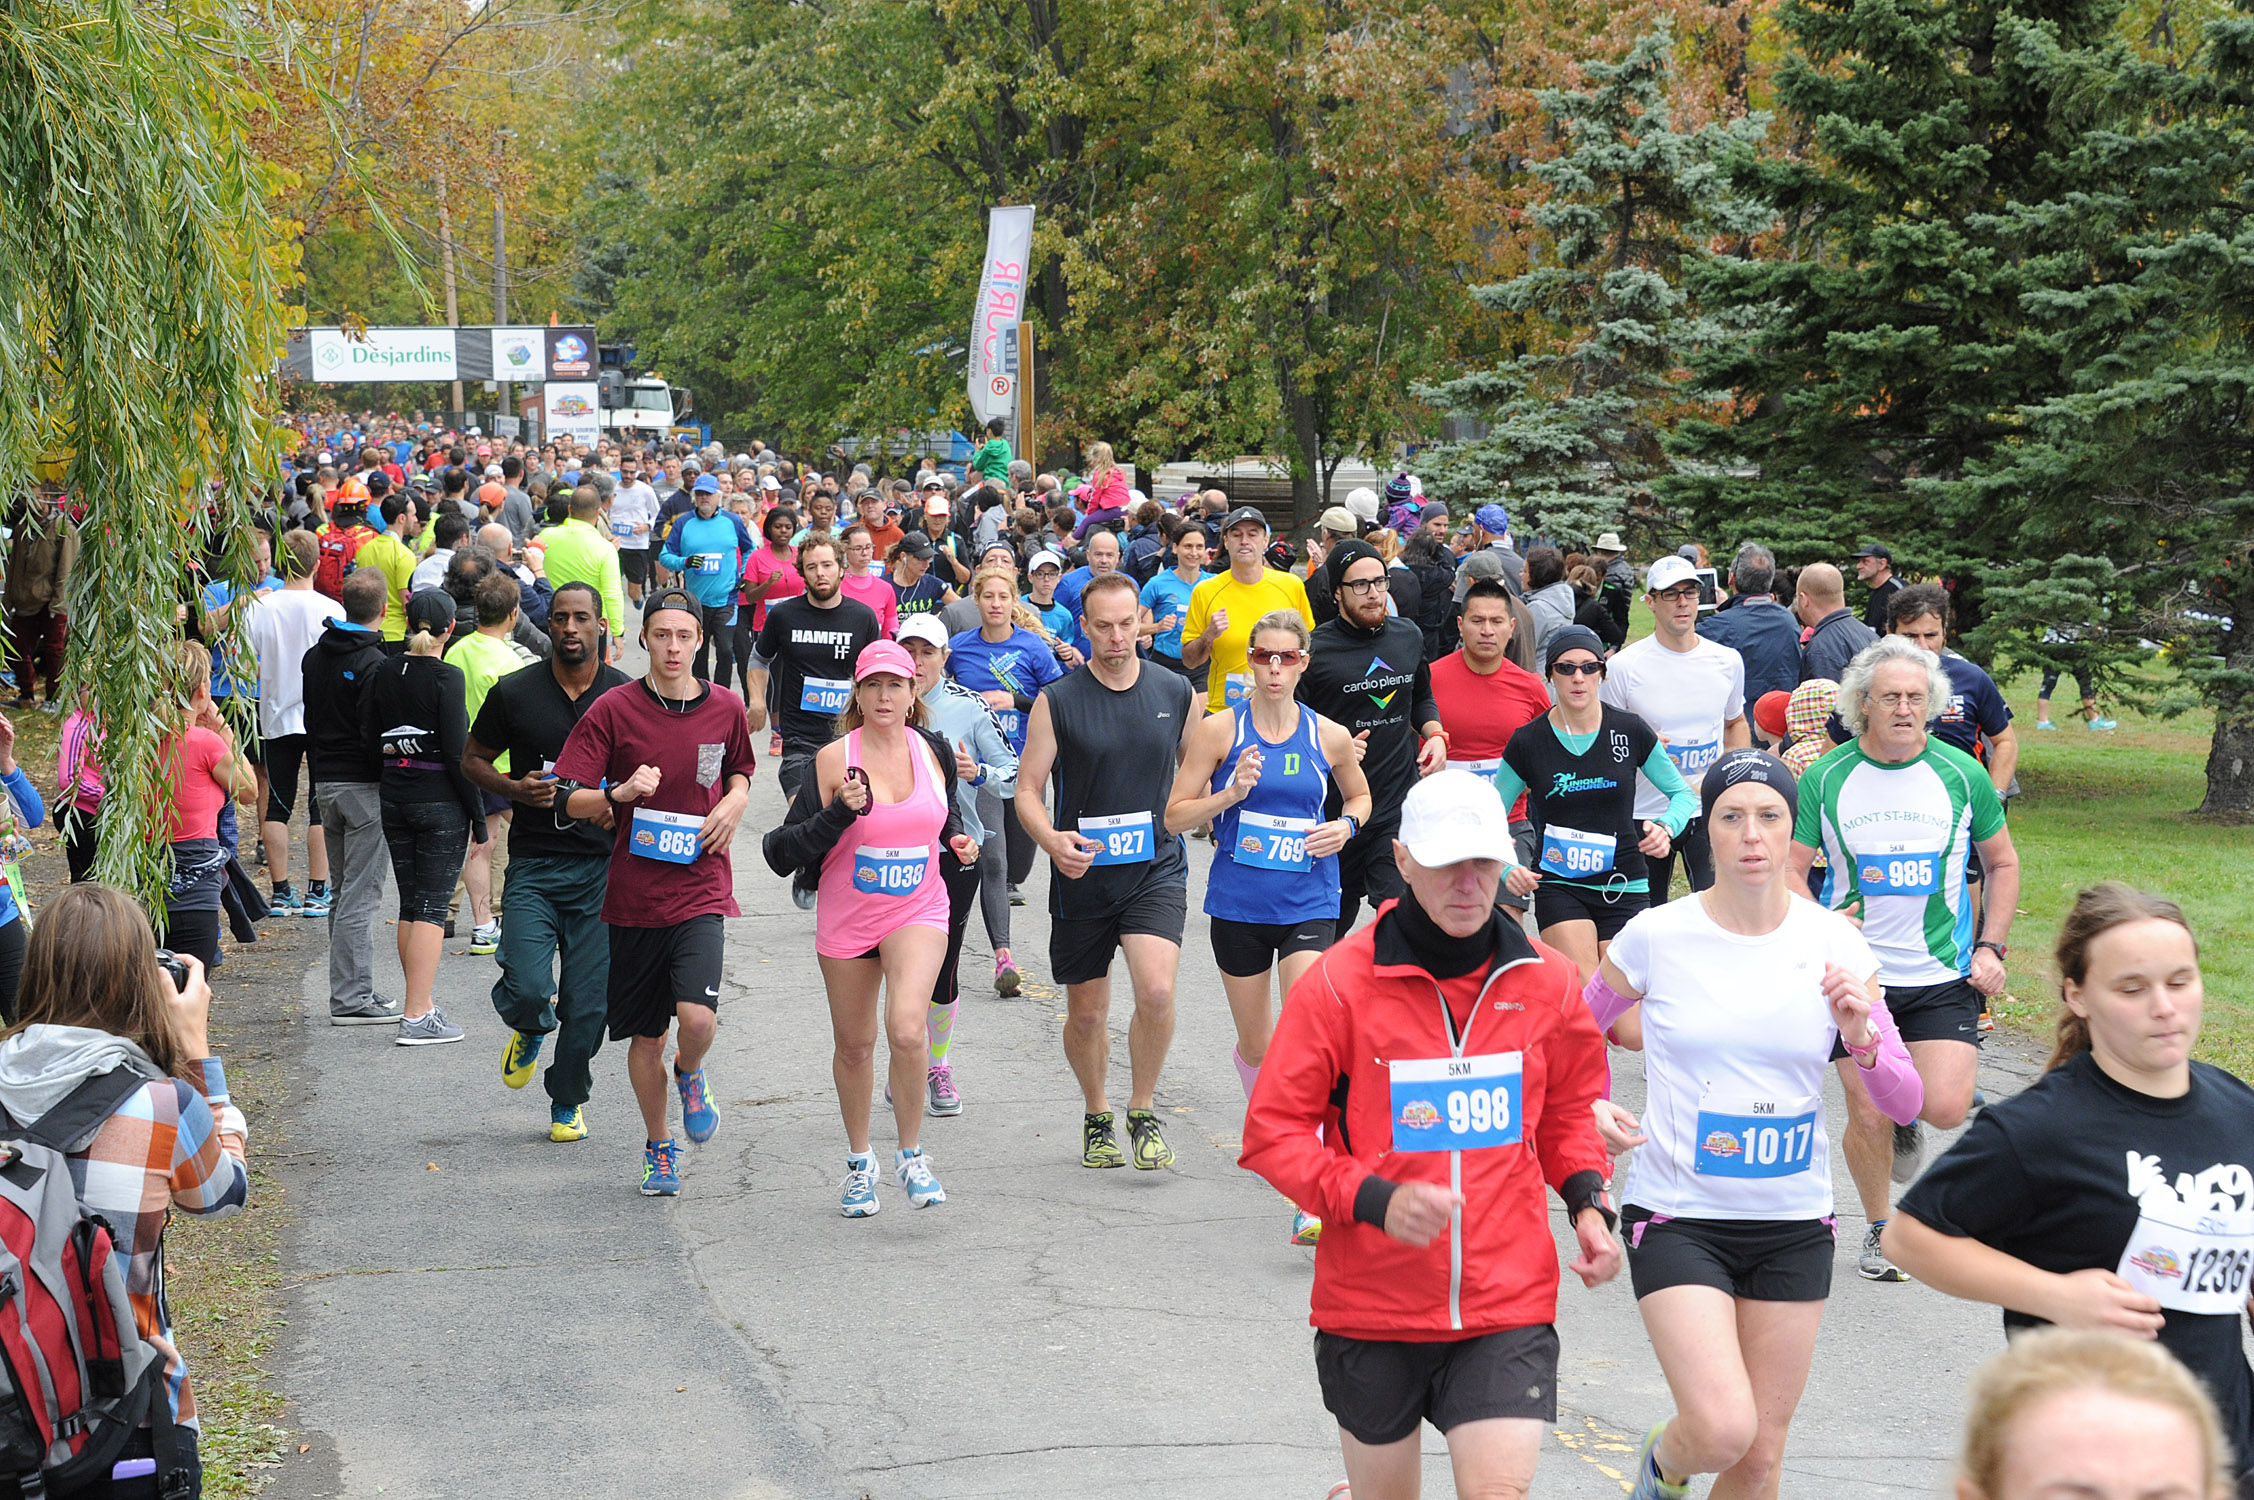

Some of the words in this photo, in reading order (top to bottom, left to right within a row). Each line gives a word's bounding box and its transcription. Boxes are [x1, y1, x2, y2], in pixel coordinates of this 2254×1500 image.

[353, 346, 452, 368] Desjardins
[704, 560, 719, 571] 714
[792, 629, 853, 645] HAMFIT
[834, 646, 850, 659] HF
[1343, 678, 1378, 693] cardio
[397, 738, 423, 754] 161
[1284, 753, 1300, 775] D
[1681, 746, 1716, 769] 1032
[1568, 781, 1618, 792] COUREUR
[664, 815, 678, 823] 5KM
[1273, 819, 1287, 827] 5KM
[1843, 812, 1880, 832] MONT
[1884, 811, 1949, 830] ST-BRUNO
[658, 830, 696, 856] 863
[1108, 830, 1144, 856] 927
[1267, 835, 1305, 862] 769
[1890, 844, 1904, 852] 5KM
[1567, 846, 1604, 872] 956
[879, 864, 924, 888] 1038
[1888, 860, 1932, 887] 985
[1449, 1062, 1471, 1076] 5KM
[1448, 1086, 1510, 1134] 998
[1753, 1102, 1774, 1114] 5KM
[1742, 1122, 1812, 1164] 1017
[2183, 1247, 2250, 1293] 1236
